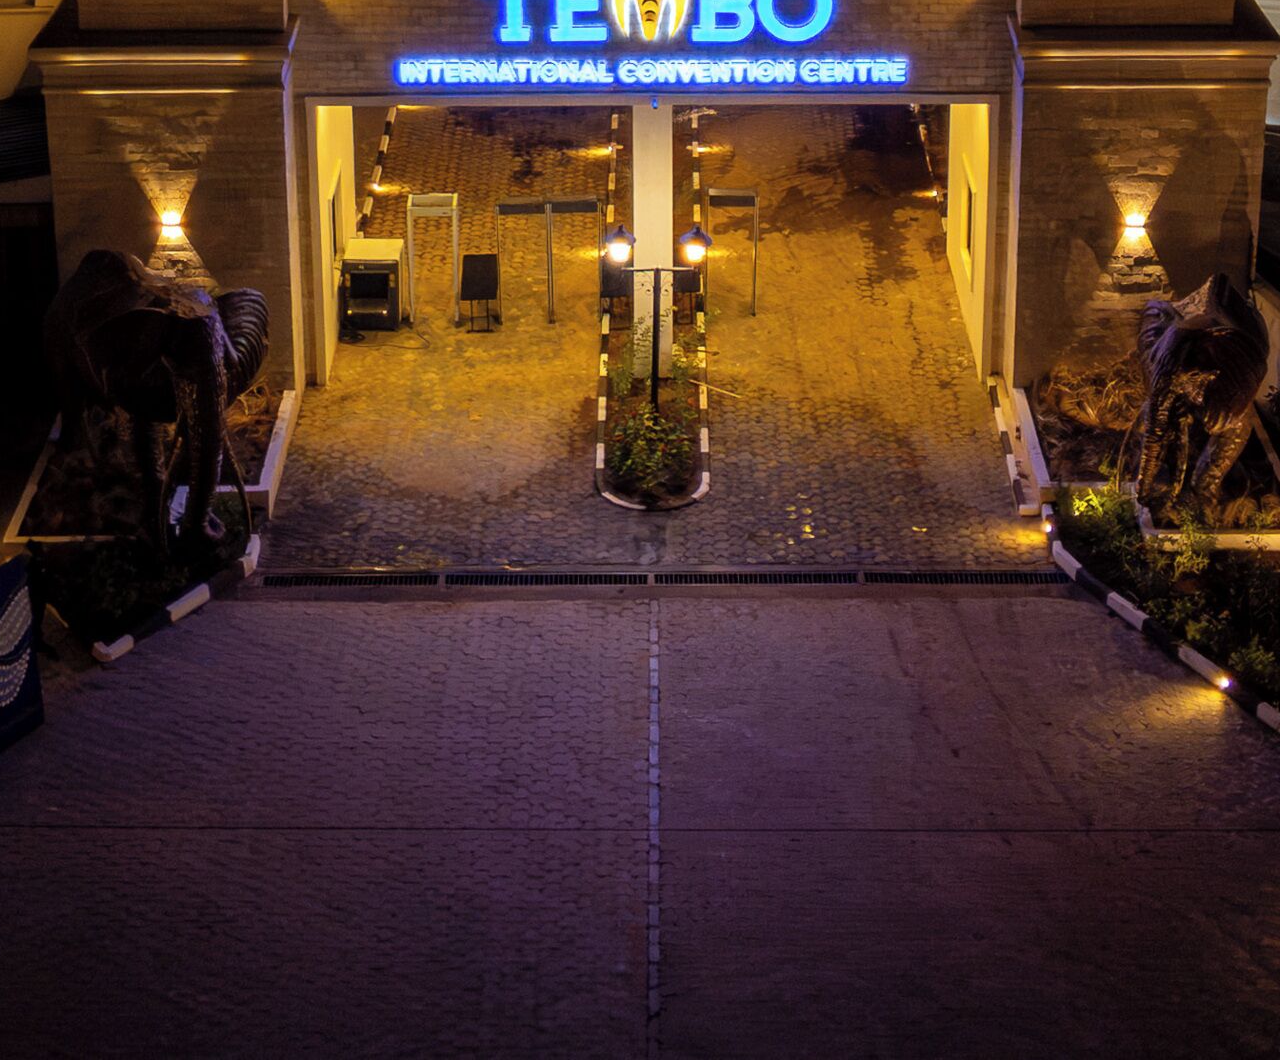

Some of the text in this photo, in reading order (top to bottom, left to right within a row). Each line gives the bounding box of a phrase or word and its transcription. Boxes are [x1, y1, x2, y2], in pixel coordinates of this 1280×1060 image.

[398, 58, 906, 84] INTERNATIONAL CONVENTION CENTRE
